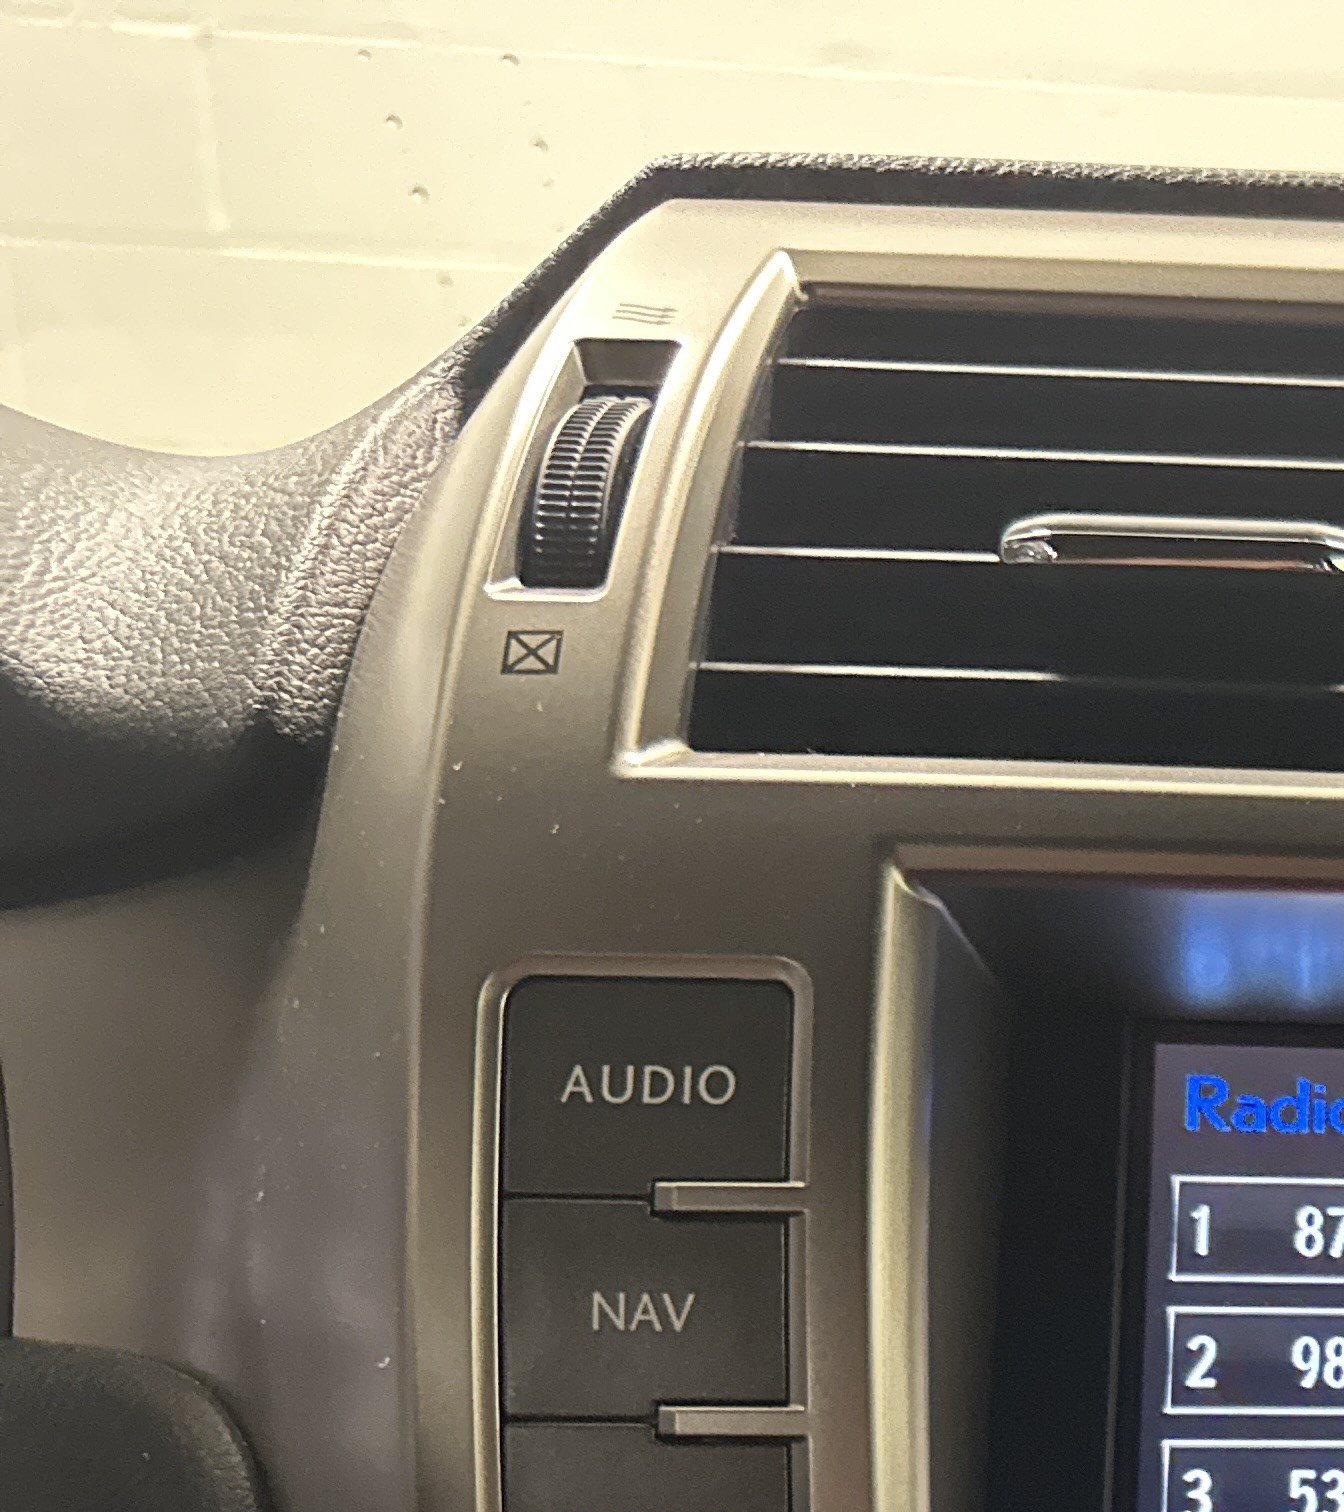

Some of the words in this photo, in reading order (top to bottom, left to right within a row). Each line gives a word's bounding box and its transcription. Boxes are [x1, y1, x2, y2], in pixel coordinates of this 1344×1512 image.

[560, 1064, 737, 1107] AUDIO
[1190, 1204, 1213, 1255] 1
[590, 1292, 696, 1333] NAV
[1184, 1336, 1218, 1389] 2
